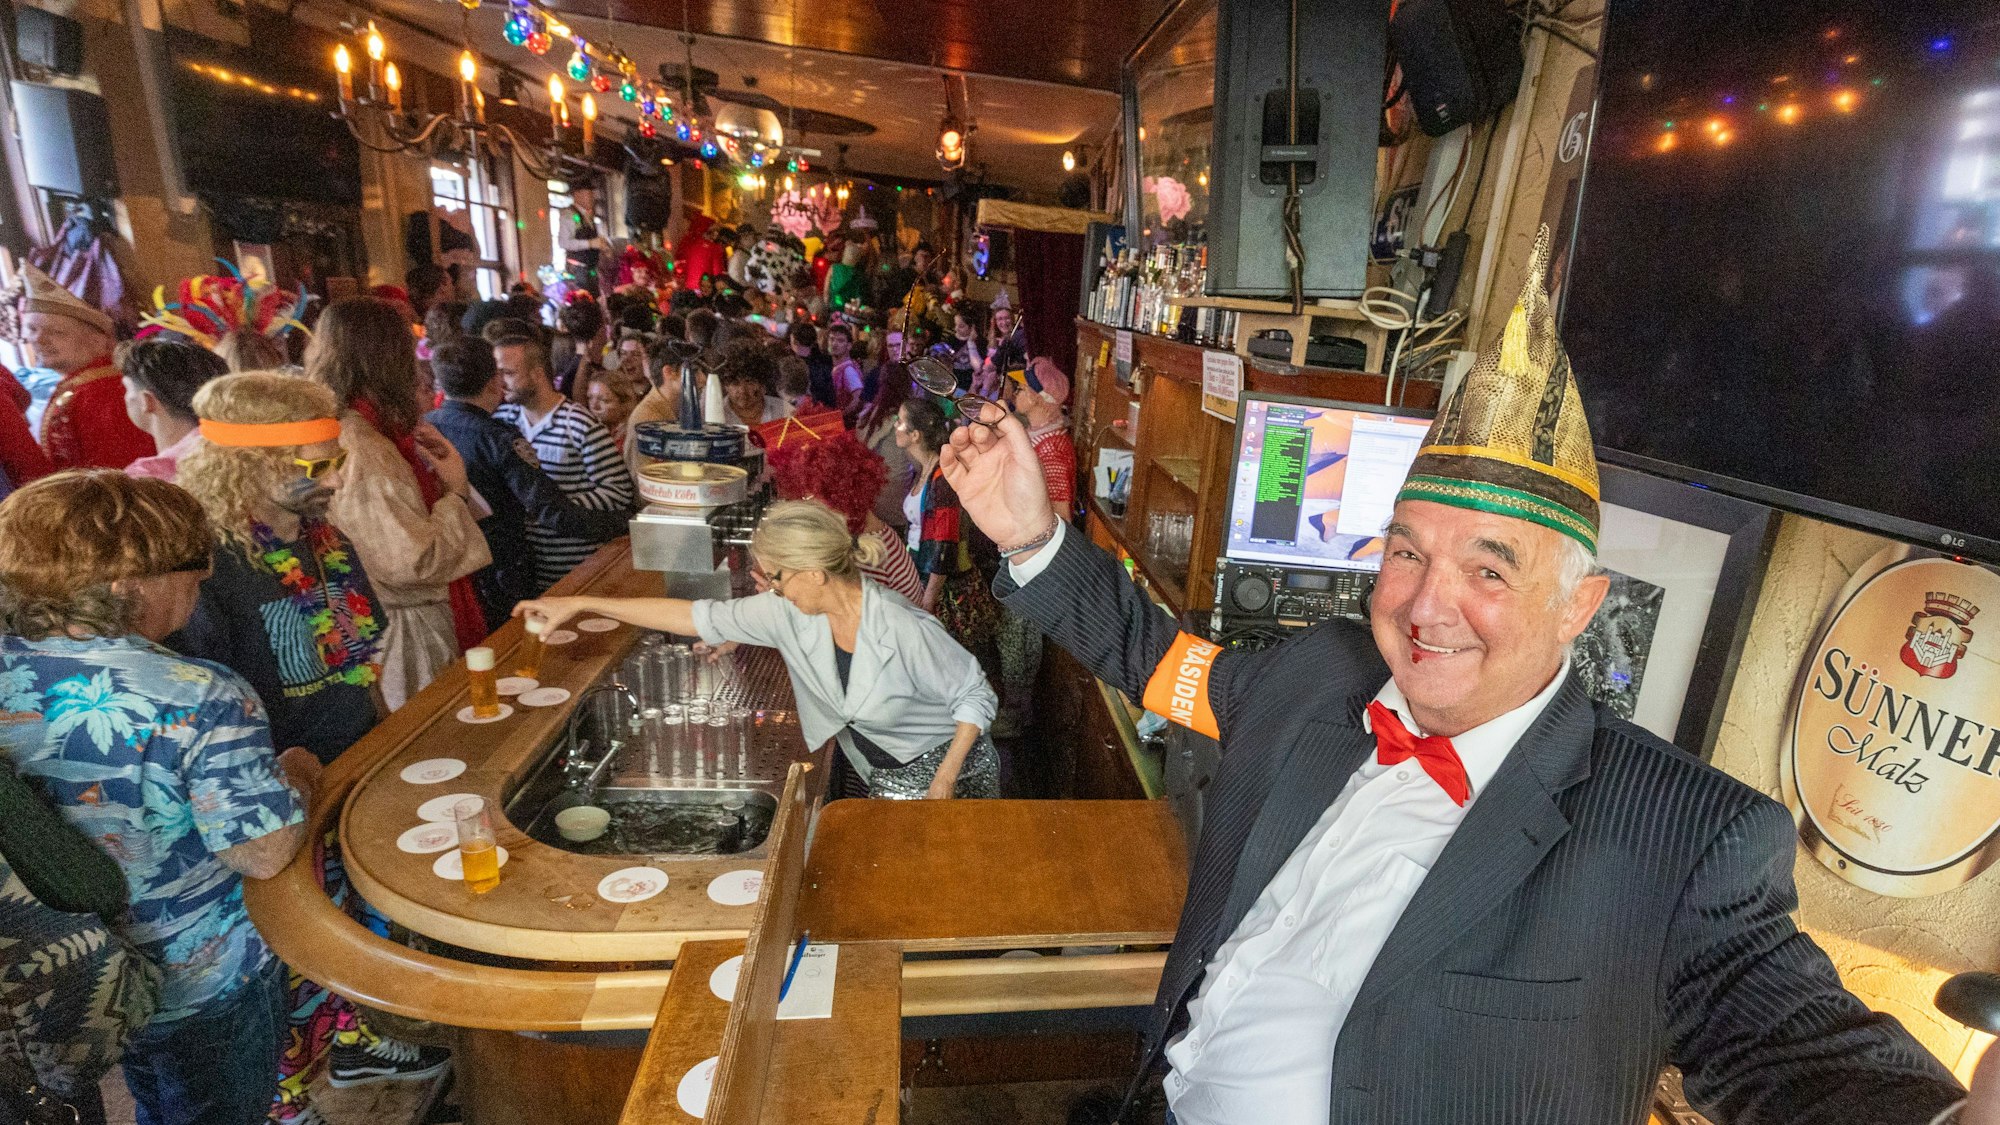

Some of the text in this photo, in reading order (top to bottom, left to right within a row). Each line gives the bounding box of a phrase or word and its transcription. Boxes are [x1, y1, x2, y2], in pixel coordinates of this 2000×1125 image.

[1952, 537, 1966, 548] LG
[1214, 573, 1225, 604] Numark
[283, 680, 325, 698] MUSIC
[1828, 725, 1930, 793] Malz
[1837, 794, 1864, 815] Seit
